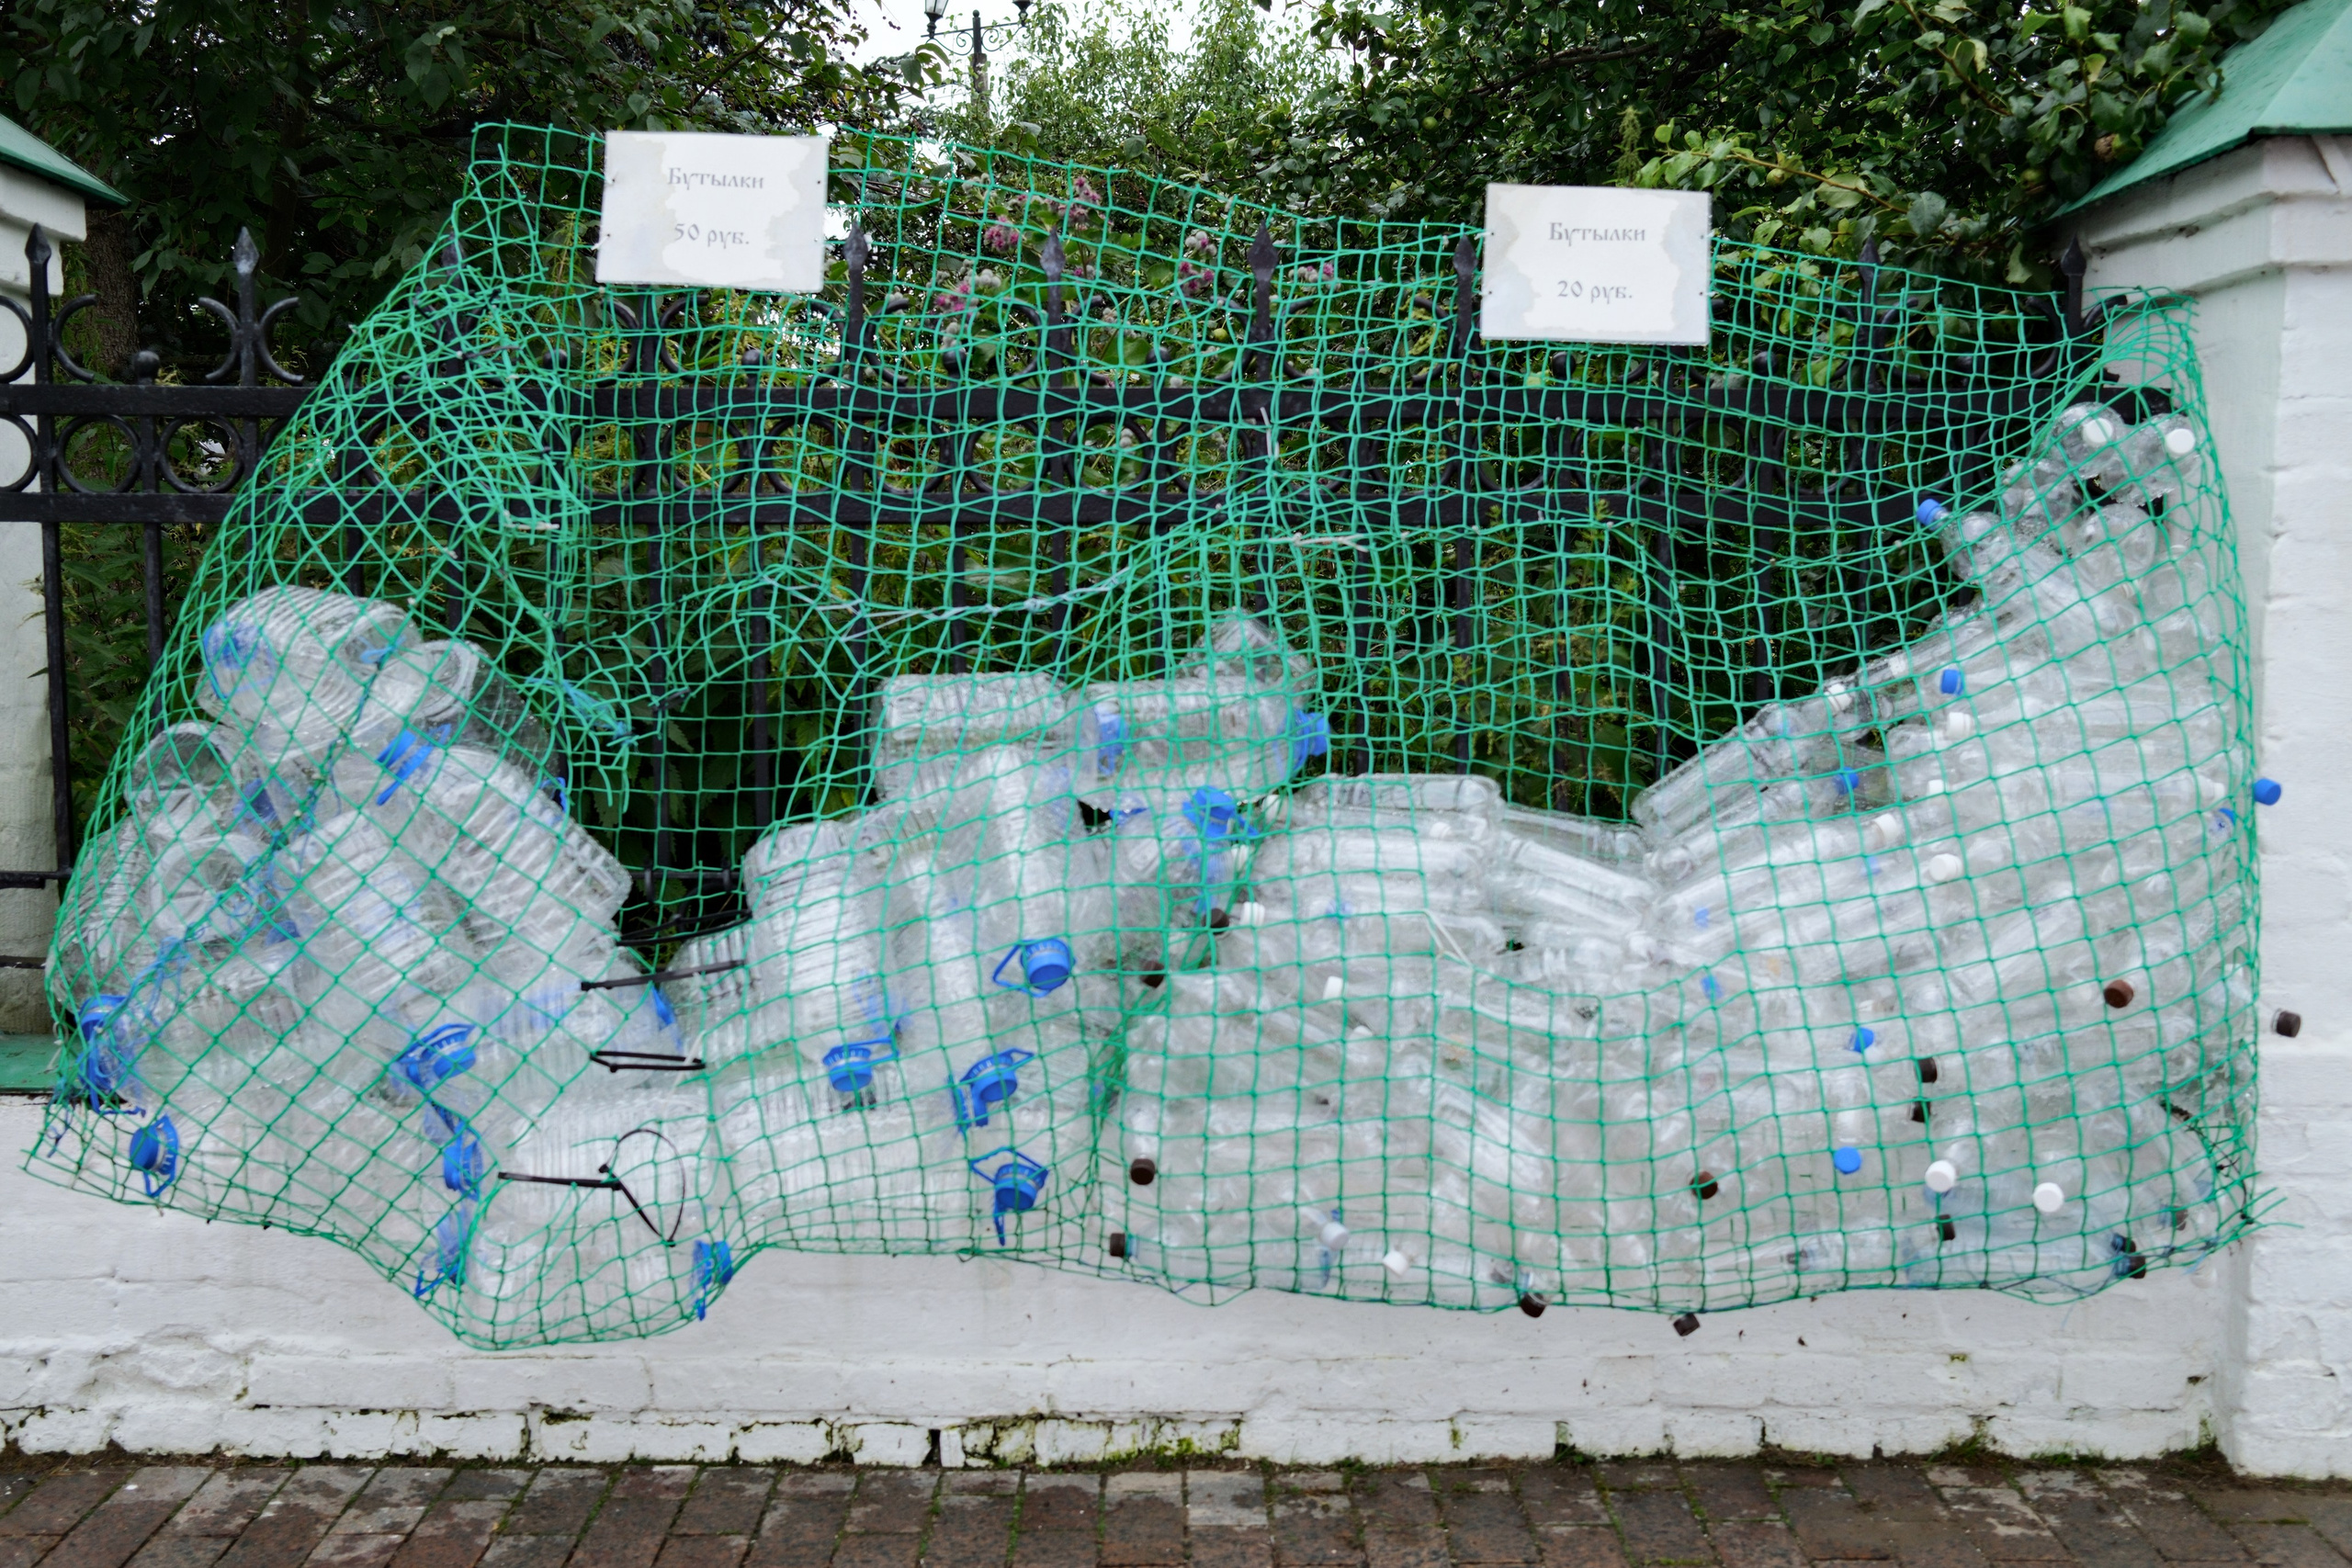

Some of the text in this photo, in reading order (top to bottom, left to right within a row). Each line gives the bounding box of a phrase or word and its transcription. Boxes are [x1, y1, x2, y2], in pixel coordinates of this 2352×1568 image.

[668, 167, 763, 190] Бутылки
[673, 223, 750, 249] 50 руб.
[1548, 222, 1645, 246] Бутылки
[1557, 280, 1633, 304] 20 руб.
